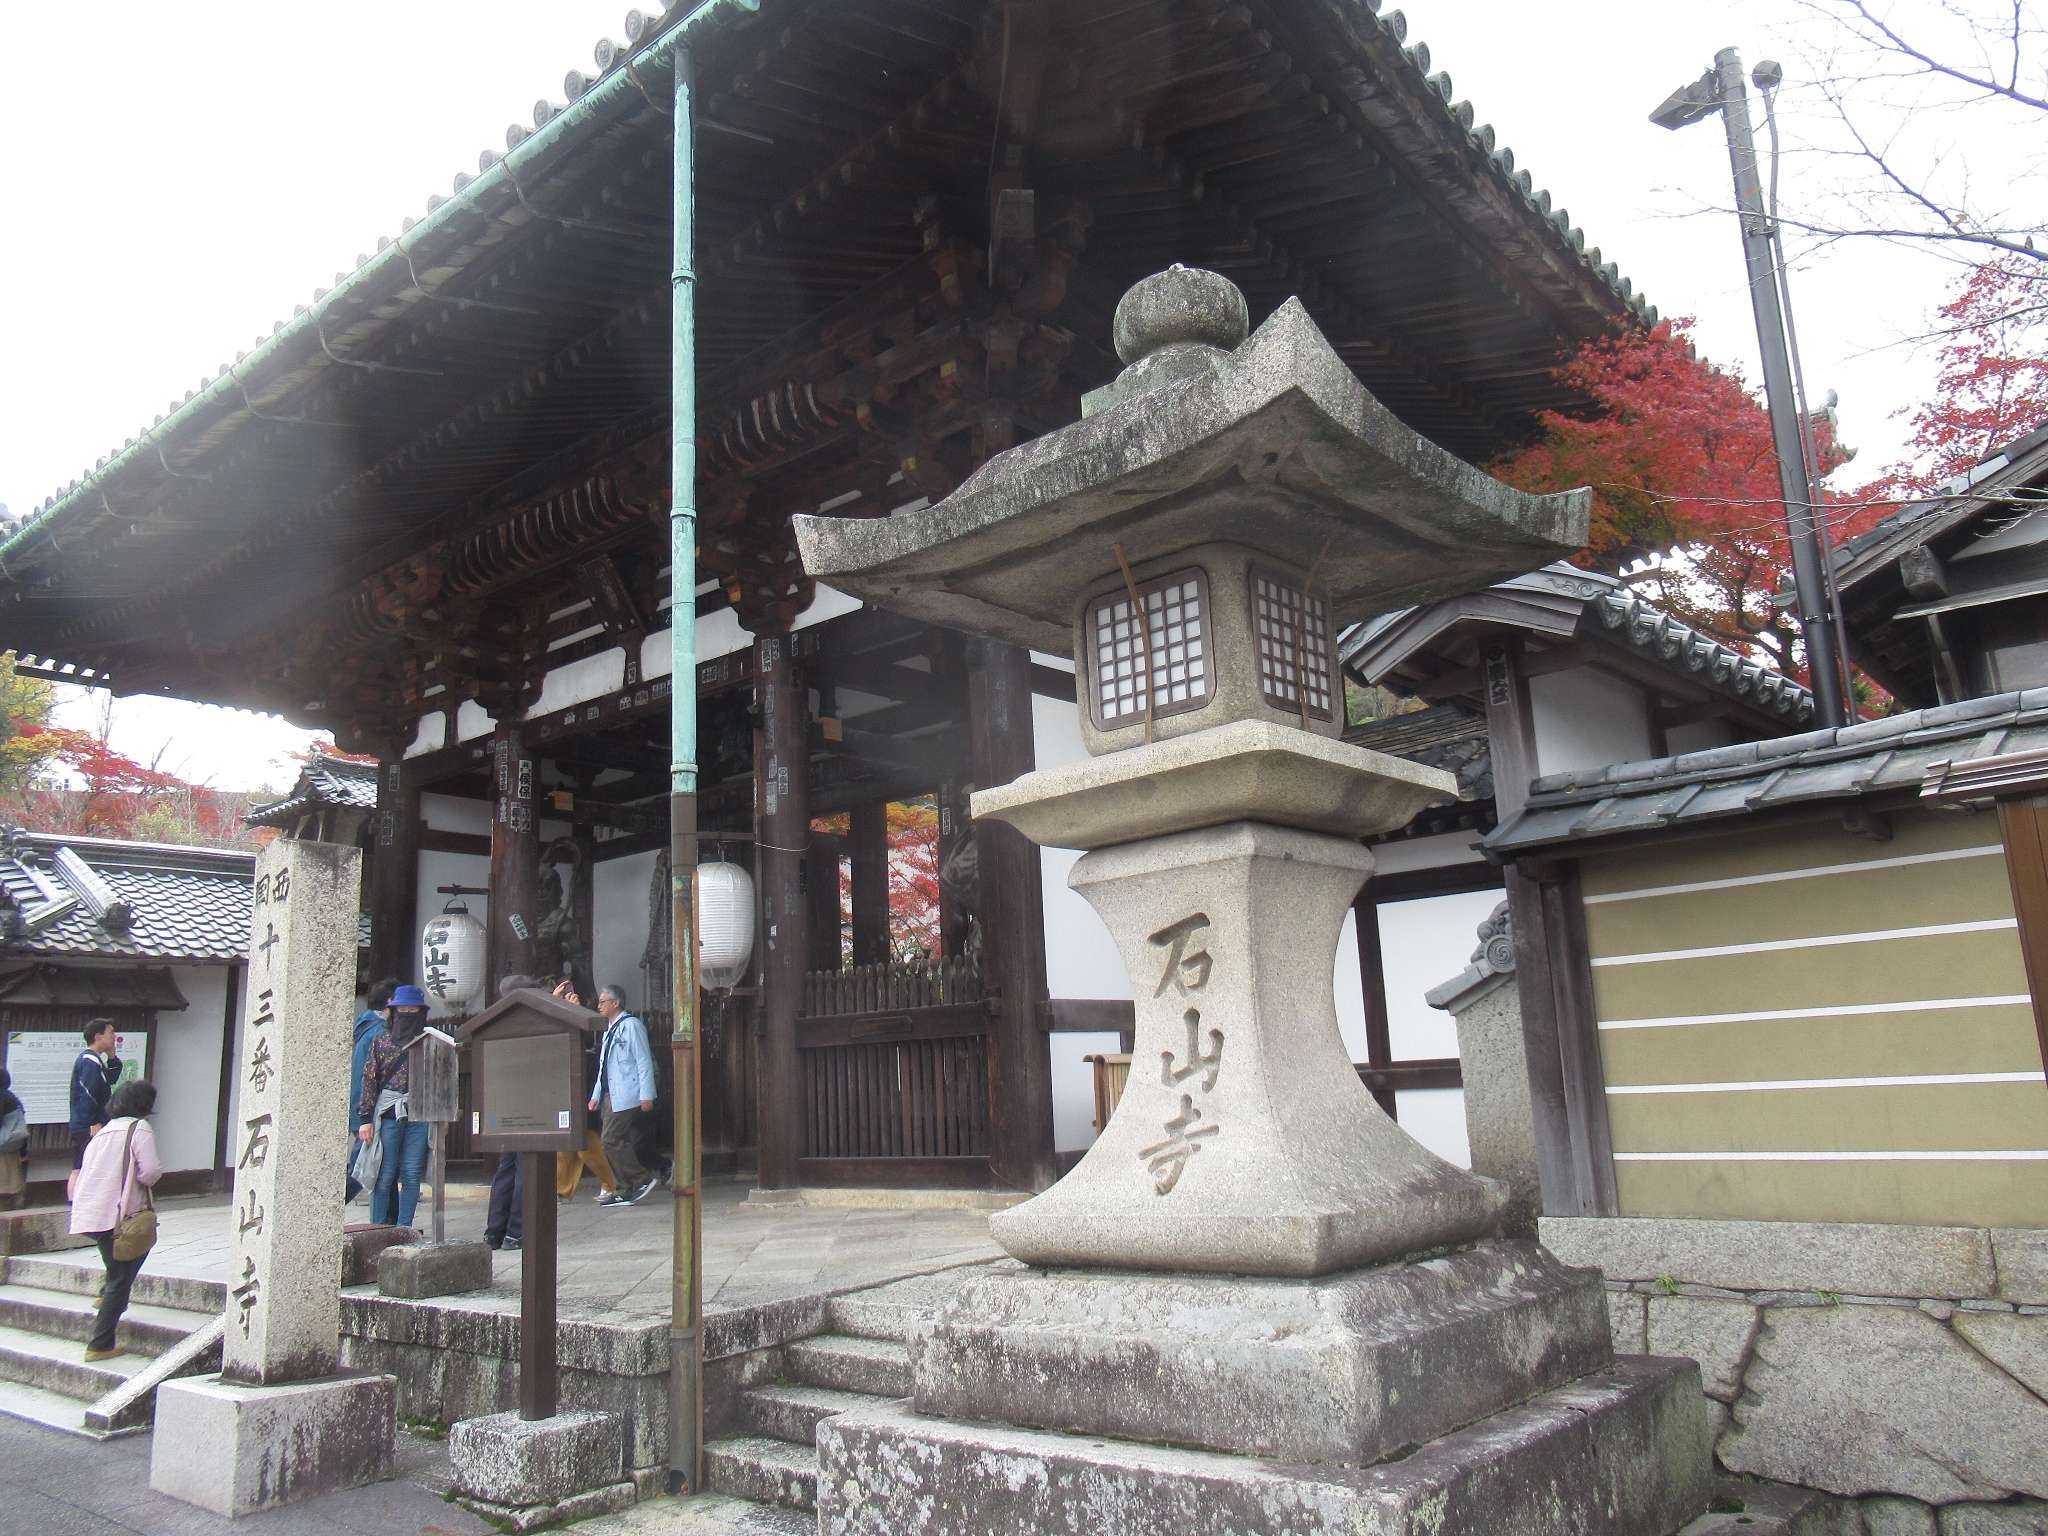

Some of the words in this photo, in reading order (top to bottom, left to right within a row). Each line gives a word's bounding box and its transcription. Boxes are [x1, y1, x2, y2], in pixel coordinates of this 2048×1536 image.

[423, 920, 456, 999] 石山寺
[1138, 911, 1225, 1197] 石山寺
